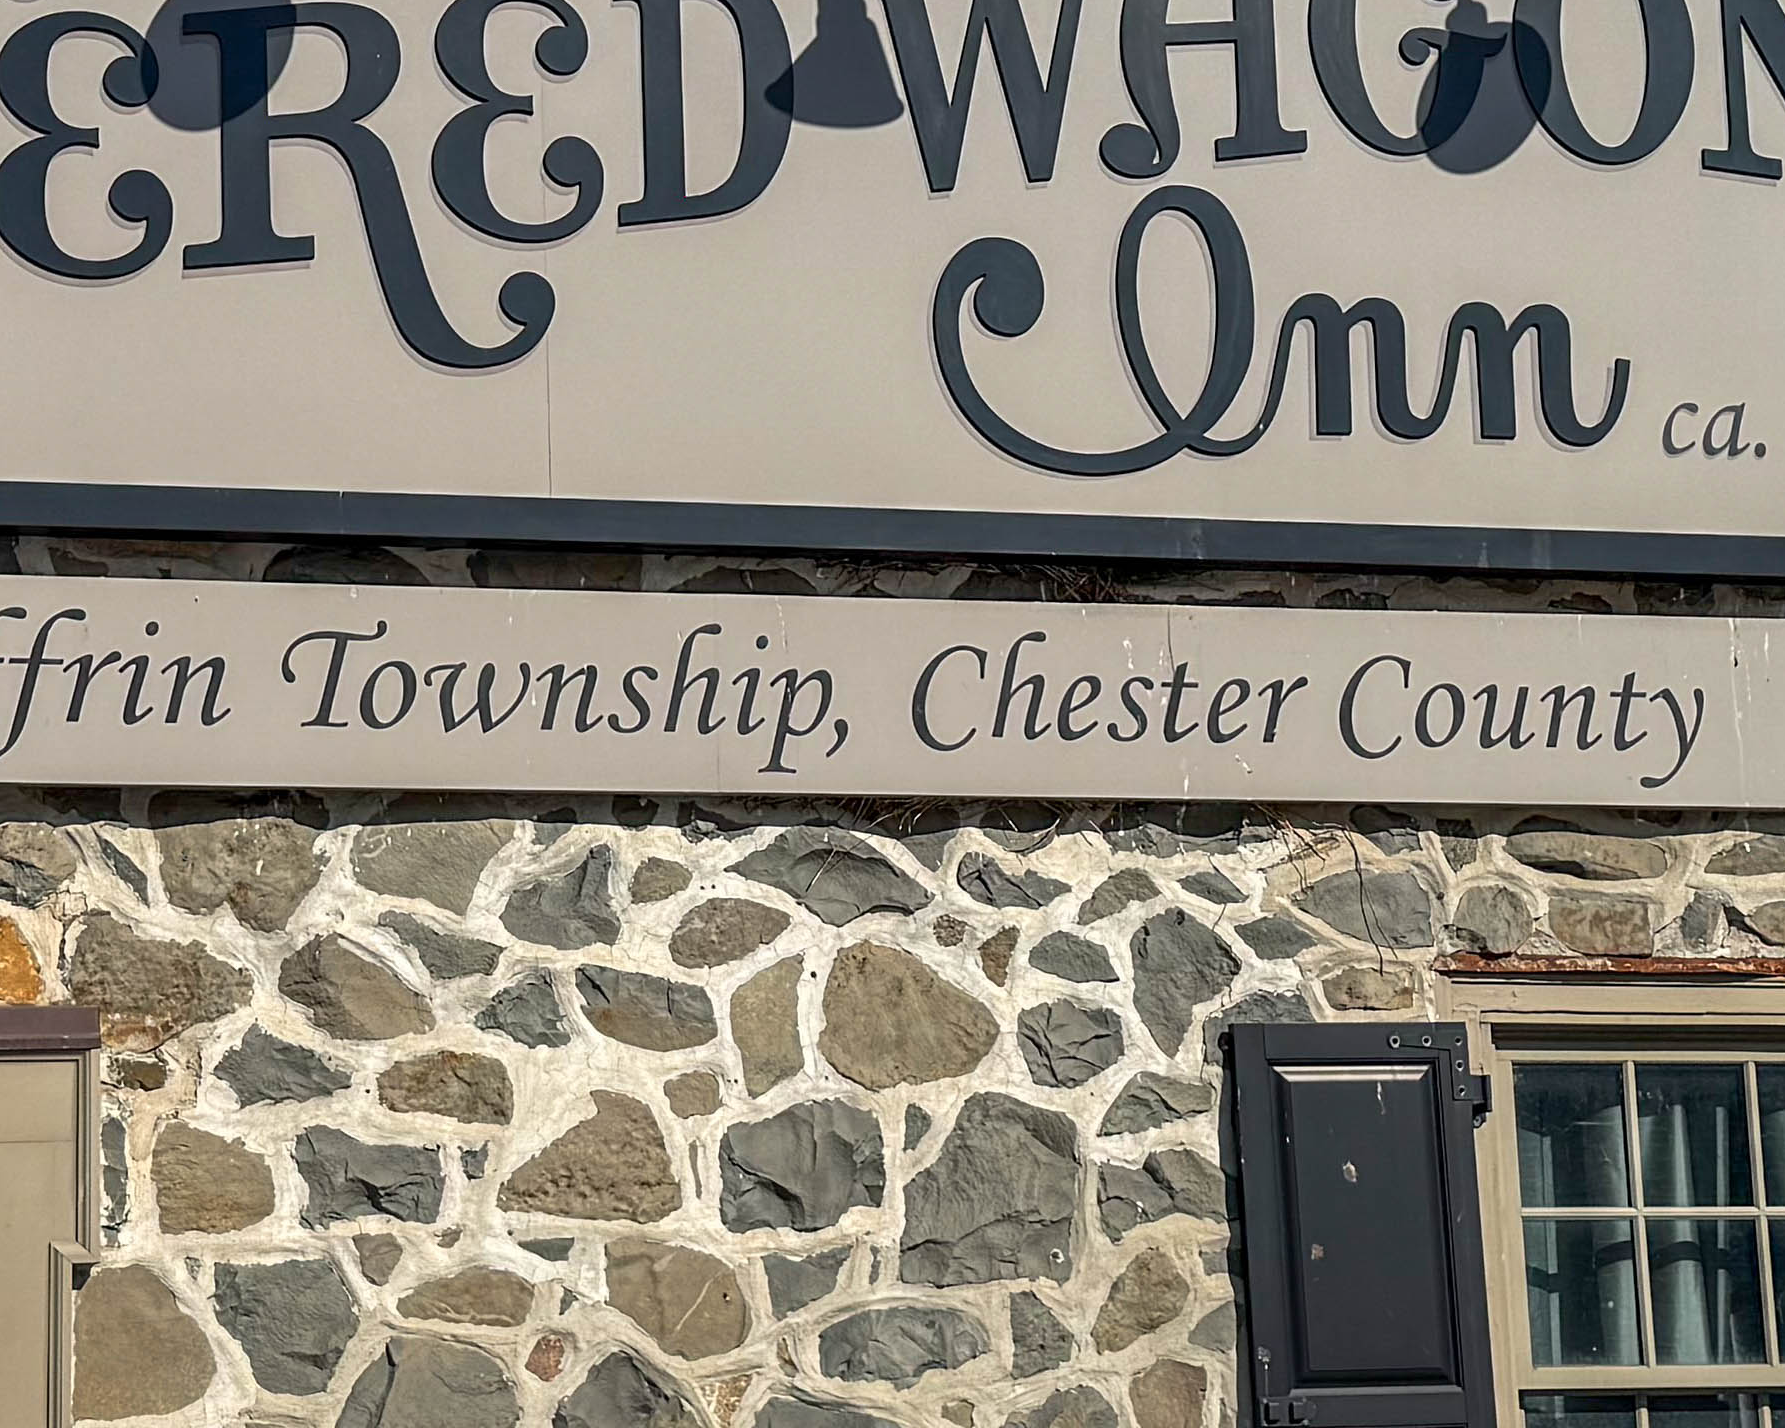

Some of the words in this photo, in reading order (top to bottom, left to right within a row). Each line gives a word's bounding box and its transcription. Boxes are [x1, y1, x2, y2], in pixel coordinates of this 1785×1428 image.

[932, 185, 1632, 478] Inn
[1661, 402, 1769, 460] ca.
[280, 622, 852, 775] Township,
[911, 632, 1309, 753] Chester
[1337, 655, 1706, 788] County
